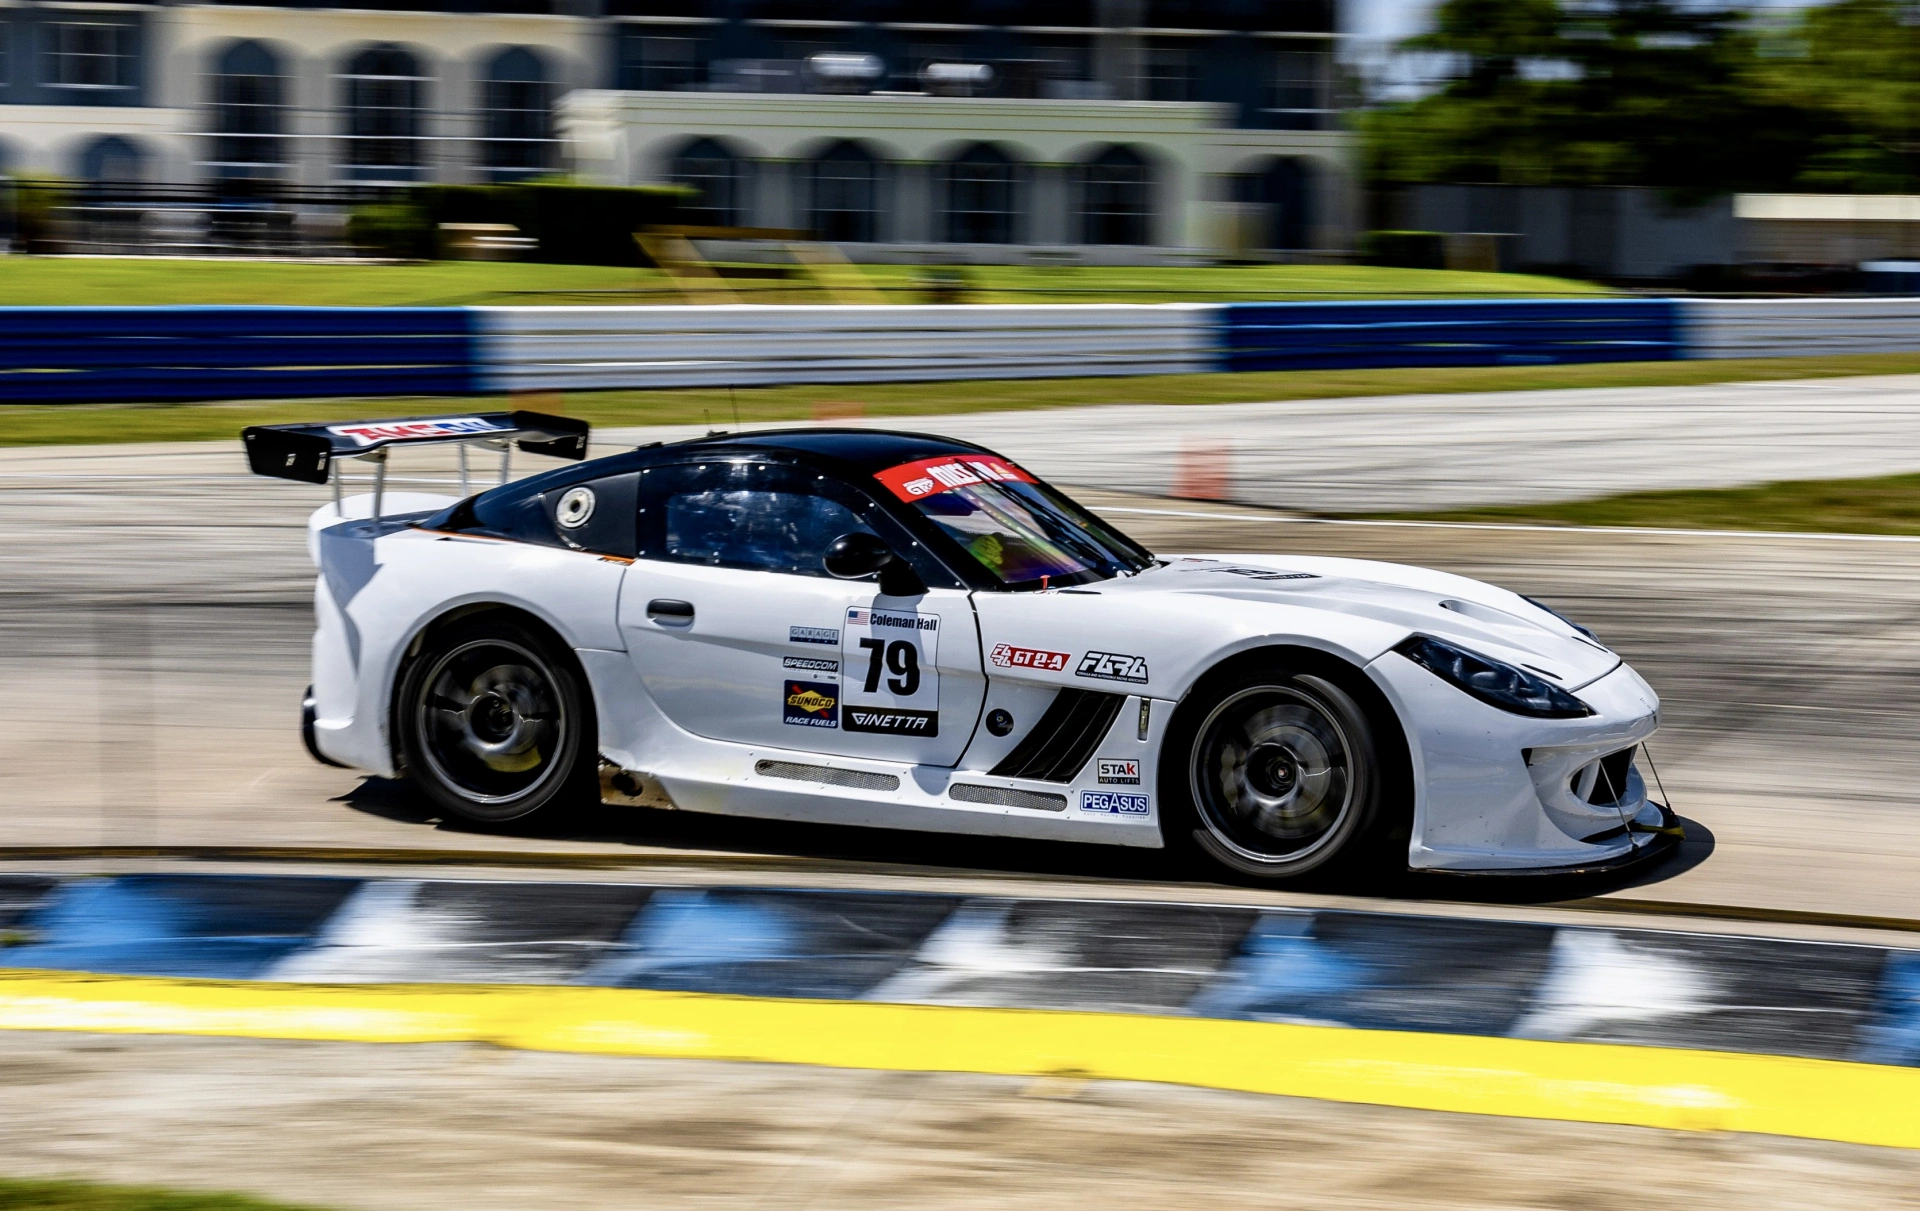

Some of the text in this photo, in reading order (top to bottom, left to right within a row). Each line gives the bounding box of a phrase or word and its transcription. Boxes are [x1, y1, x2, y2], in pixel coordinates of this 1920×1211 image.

[342, 422, 503, 440] AMSOIL
[870, 613, 938, 631] Coleman Hall
[791, 628, 836, 639] GARAGE
[783, 658, 838, 671] SPEEDCOM
[859, 637, 921, 696] 79
[1079, 652, 1147, 679] FARA
[789, 695, 833, 708] SUNOCO
[785, 716, 837, 728] RACE FUELS
[851, 712, 928, 730] GINETTA
[1083, 793, 1146, 812] PEGASUS
